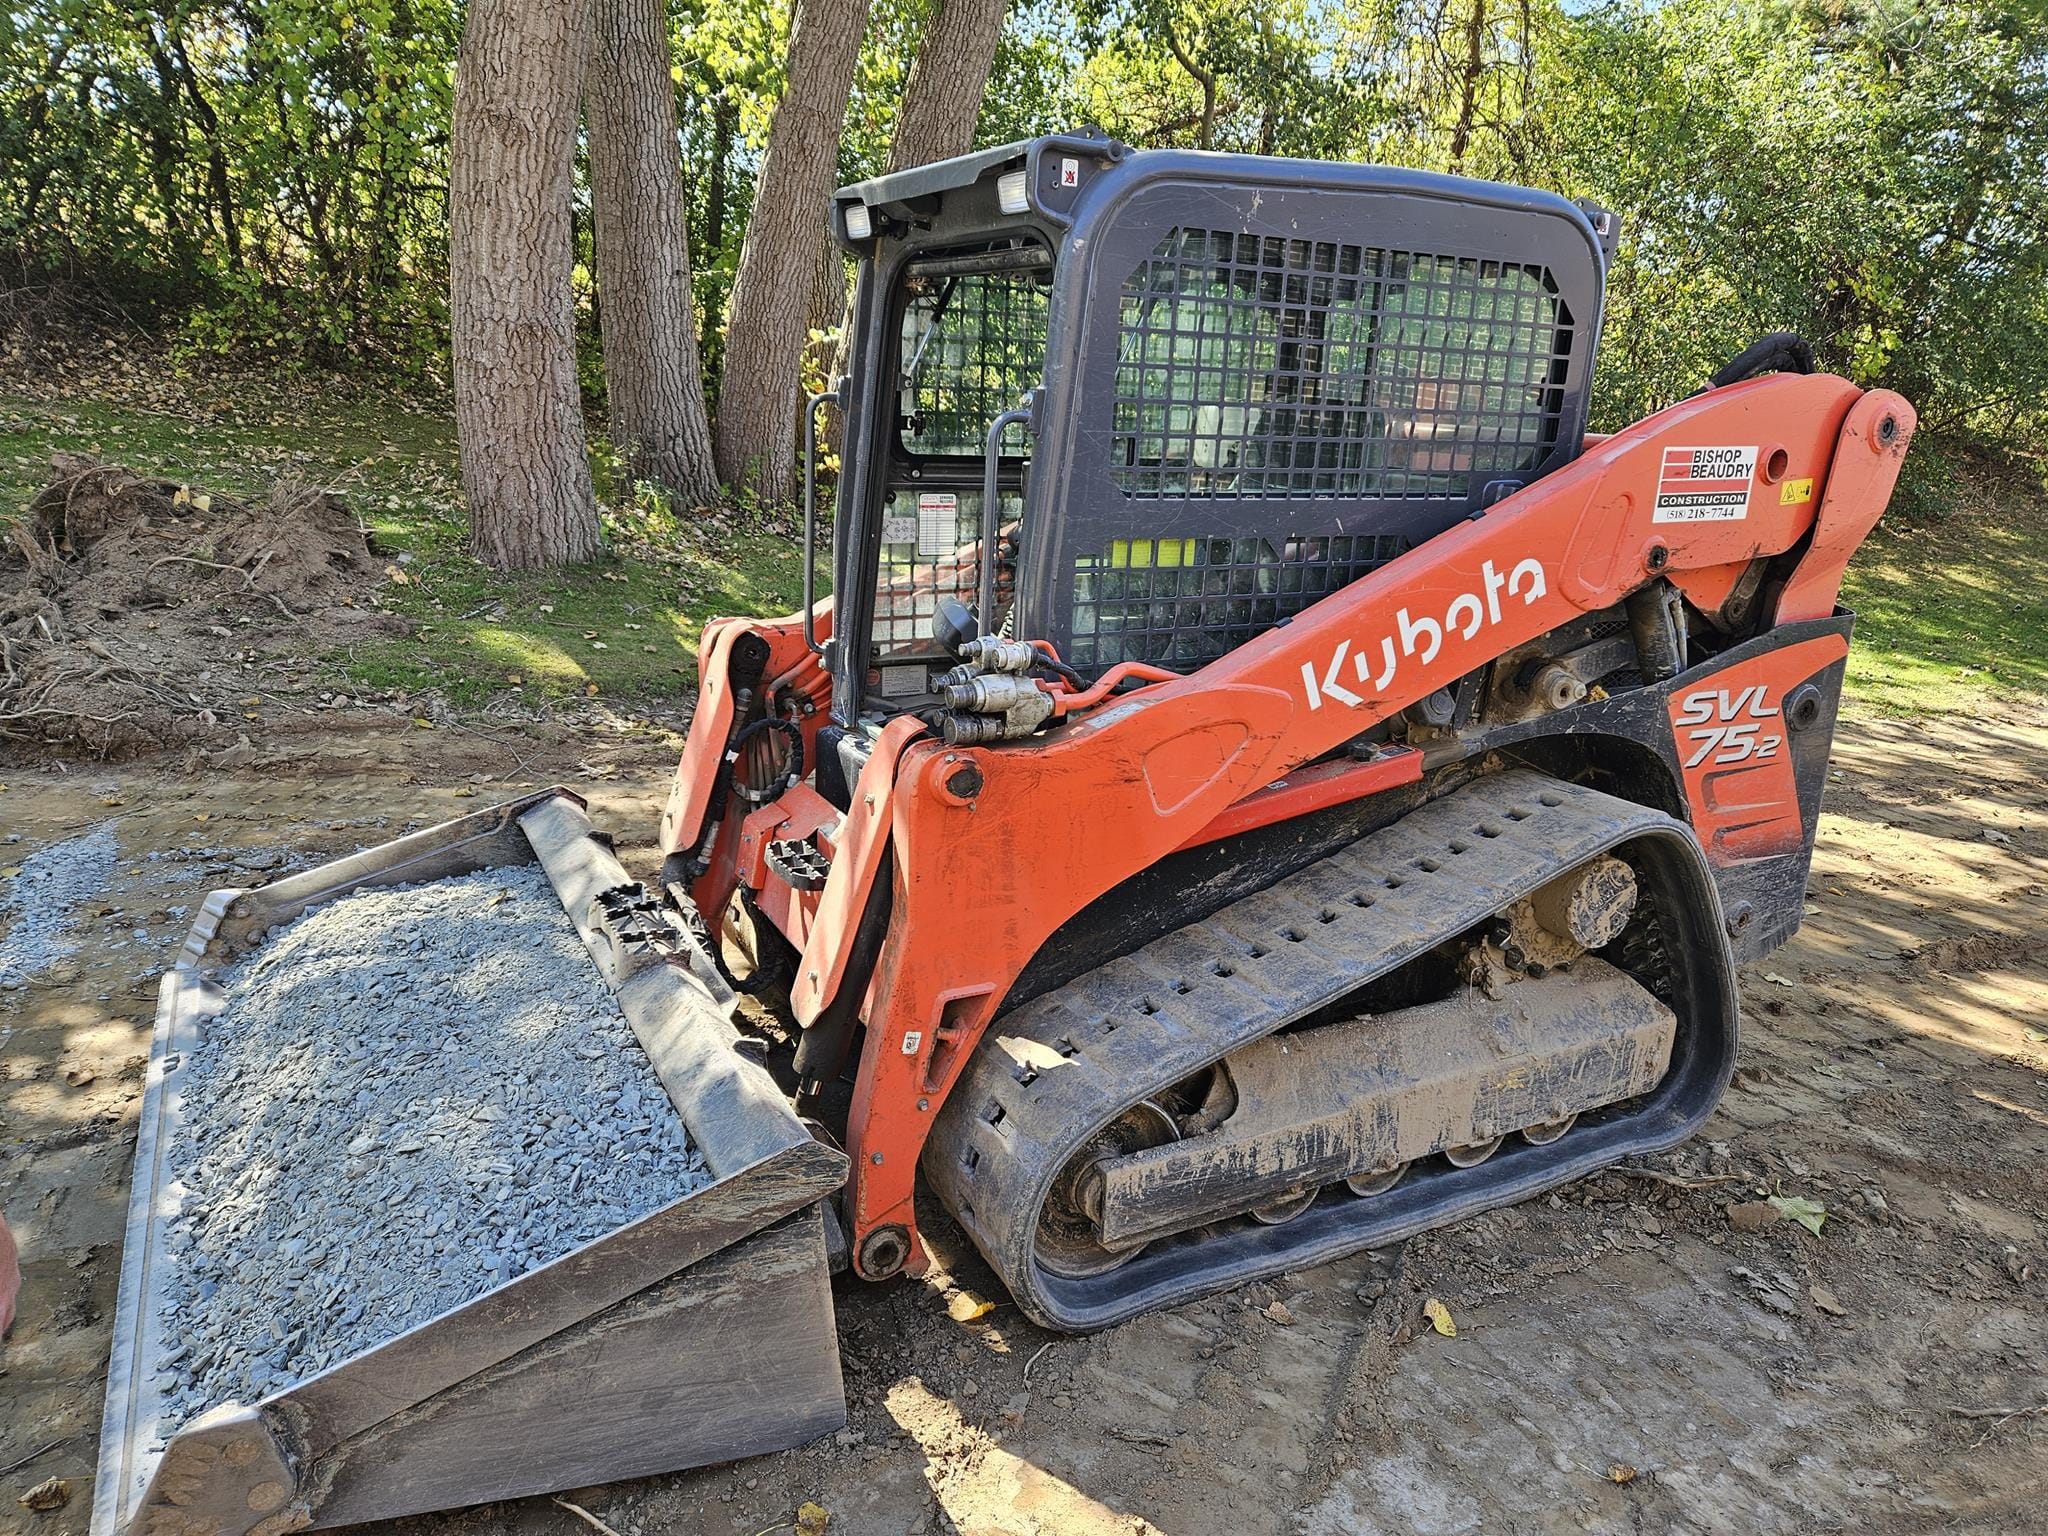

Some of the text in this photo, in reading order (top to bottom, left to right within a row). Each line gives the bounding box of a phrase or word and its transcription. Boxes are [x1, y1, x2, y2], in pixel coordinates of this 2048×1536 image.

[1693, 449, 1742, 463] BISHOP
[1691, 463, 1752, 478] BEAUDRY
[1661, 494, 1745, 505] CONSTRUCTION
[1666, 507, 1735, 519] (518) 218-7744
[1301, 558, 1547, 711] Kubota
[1675, 685, 1779, 727] SVL
[1684, 723, 1782, 769] 75-2
